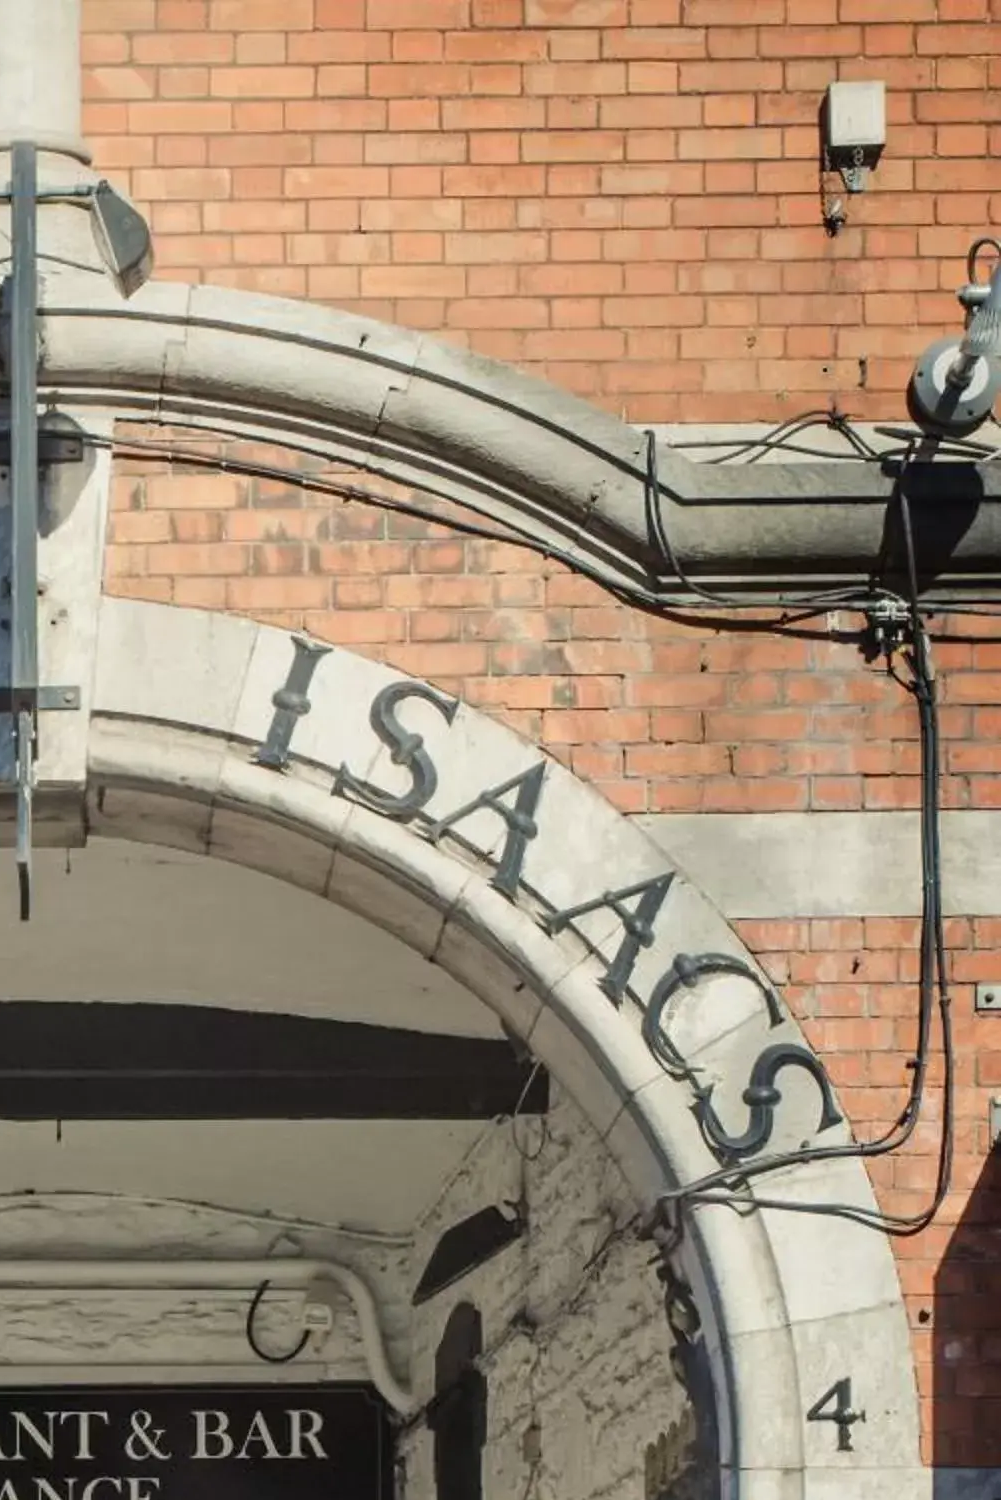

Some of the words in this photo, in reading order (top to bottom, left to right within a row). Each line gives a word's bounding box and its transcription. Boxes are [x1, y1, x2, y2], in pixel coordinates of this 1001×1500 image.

[250, 635, 843, 1166] ISAACS
[124, 1409, 172, 1461] &
[190, 1409, 328, 1460] BAR
